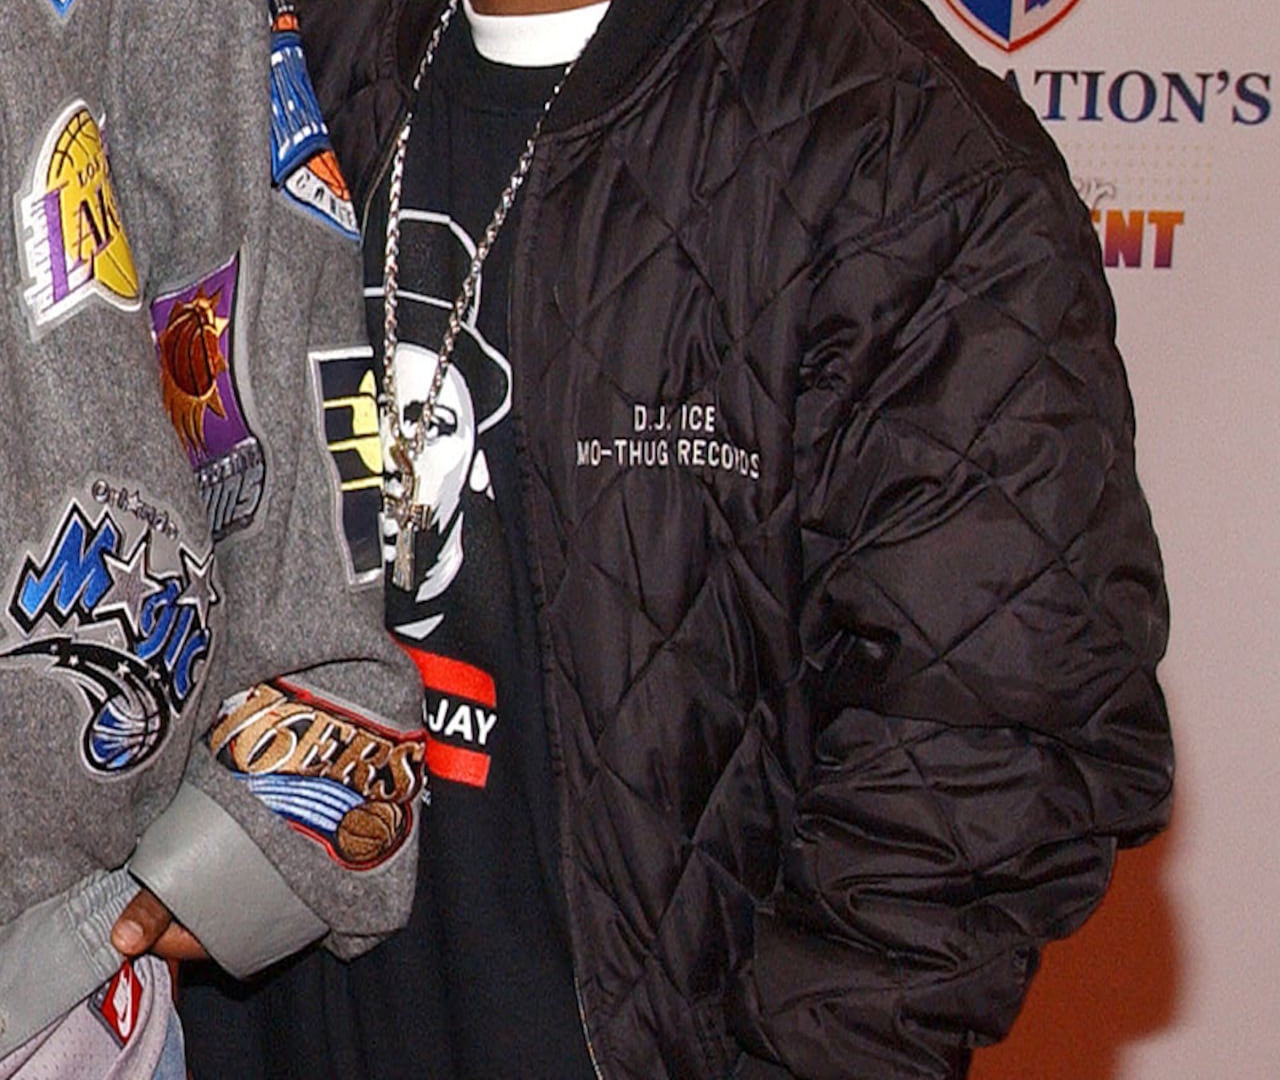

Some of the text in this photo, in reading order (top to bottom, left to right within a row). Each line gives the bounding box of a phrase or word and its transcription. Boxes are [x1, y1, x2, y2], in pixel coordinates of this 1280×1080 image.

[634, 404, 716, 433] D.J. ICE
[576, 438, 761, 481] MO-THUG RECORDS
[428, 698, 497, 745] JAY
